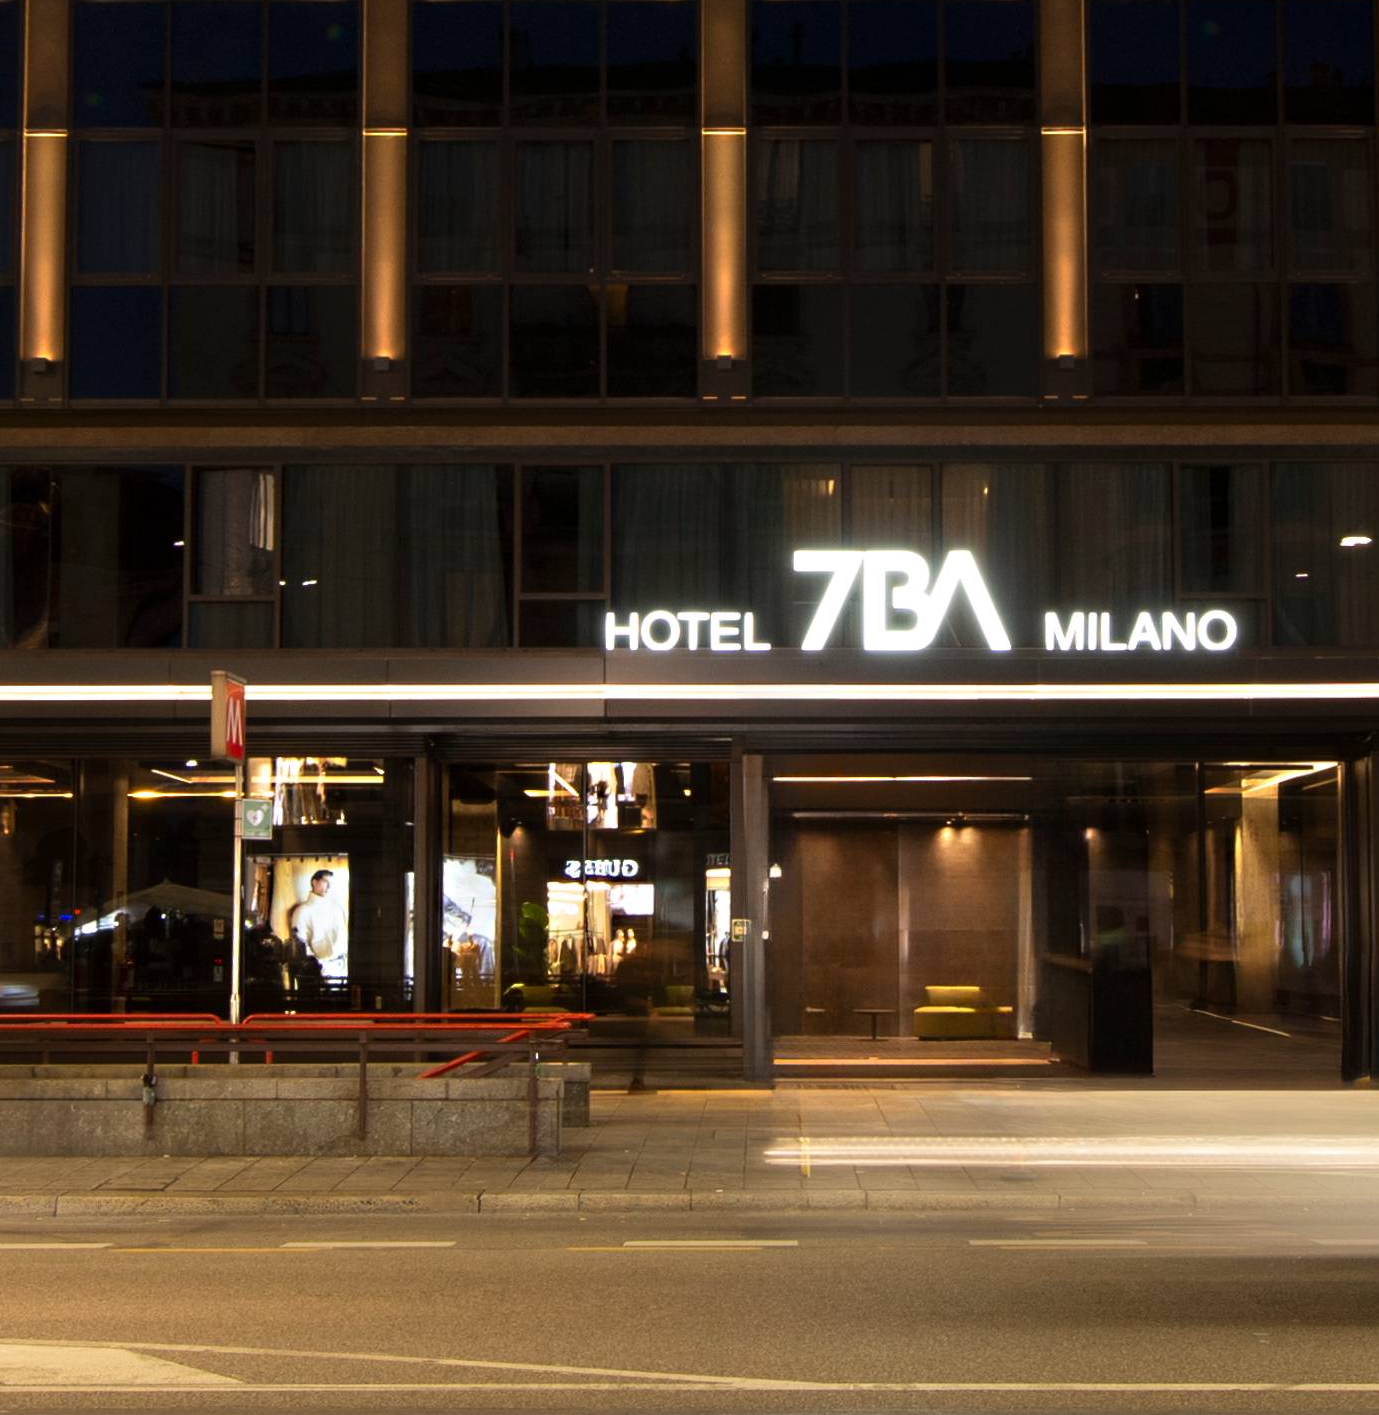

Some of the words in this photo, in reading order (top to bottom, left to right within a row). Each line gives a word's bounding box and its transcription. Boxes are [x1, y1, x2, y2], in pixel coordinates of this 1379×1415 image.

[604, 610, 771, 653] HOTEL
[1044, 610, 1238, 653] MILANO
[226, 696, 243, 747] M
